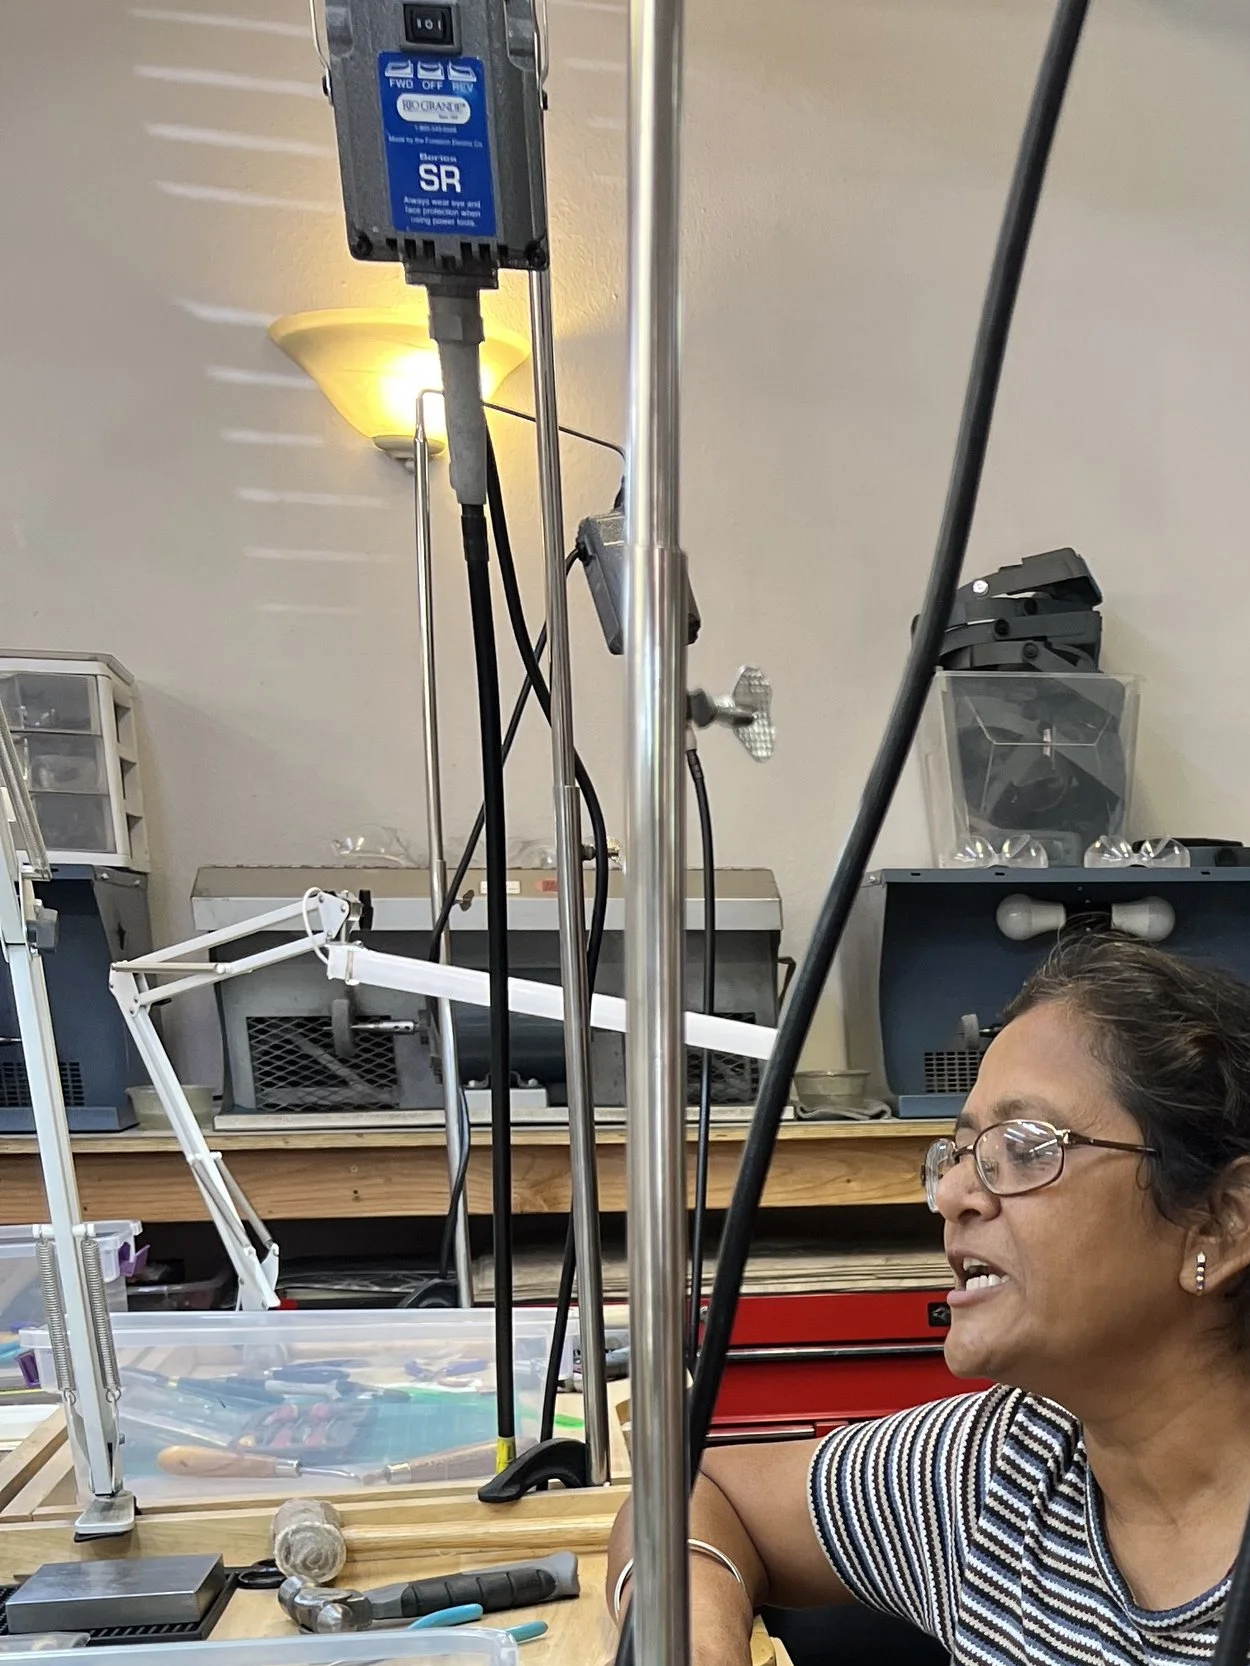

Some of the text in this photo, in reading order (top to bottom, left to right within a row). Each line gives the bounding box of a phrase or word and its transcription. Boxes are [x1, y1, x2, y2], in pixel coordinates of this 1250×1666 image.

[389, 78, 474, 93] FWD OFF REV
[402, 99, 420, 111] RIO
[418, 163, 462, 193] SR
[403, 196, 430, 207] Always
[431, 199, 450, 207] wear
[466, 200, 481, 209] and
[404, 205, 481, 218] face protection when
[432, 218, 455, 227] power
